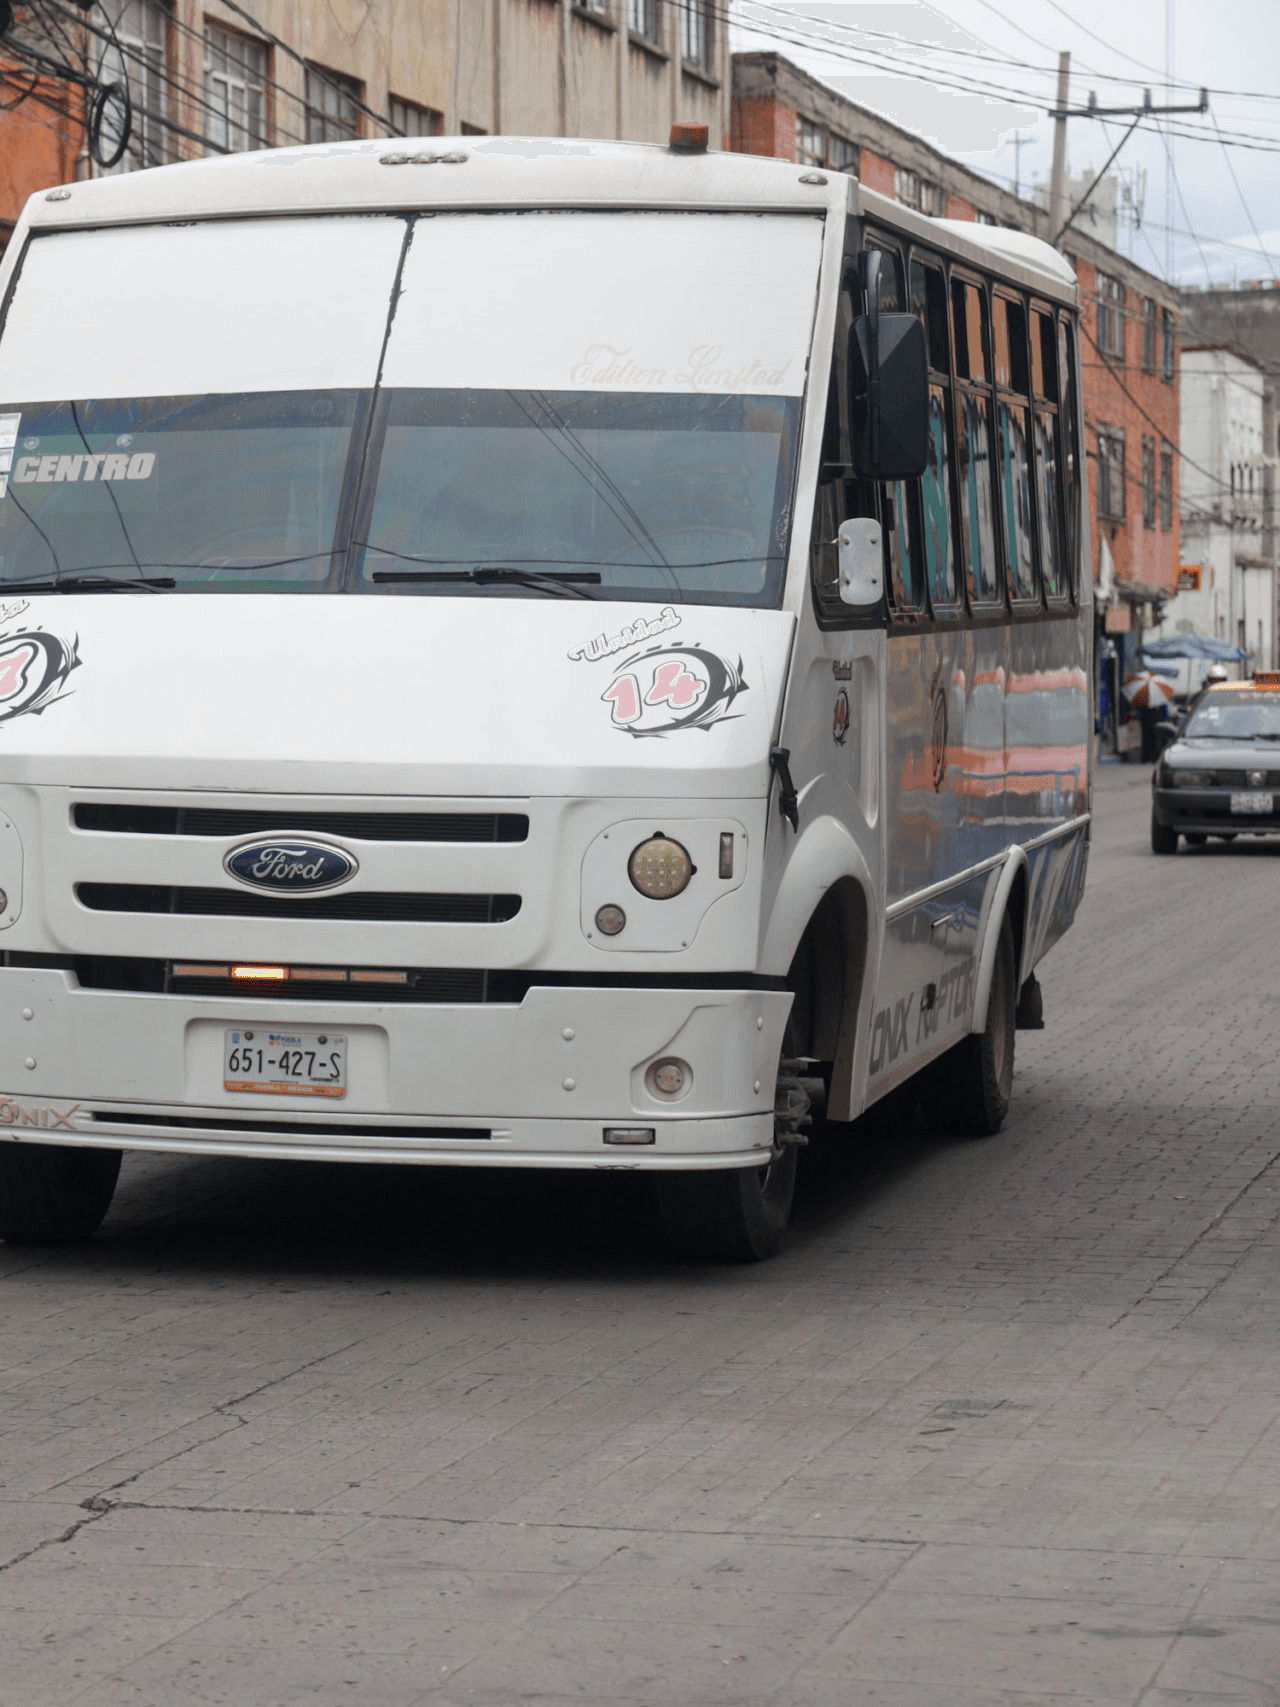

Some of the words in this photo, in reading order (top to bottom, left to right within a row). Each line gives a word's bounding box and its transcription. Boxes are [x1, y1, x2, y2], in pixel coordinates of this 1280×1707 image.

[13, 452, 156, 483] CENTRO
[568, 606, 682, 662] Unidad
[601, 661, 707, 724] 14
[251, 847, 325, 880] Ford
[228, 1047, 341, 1079] 651-427-S
